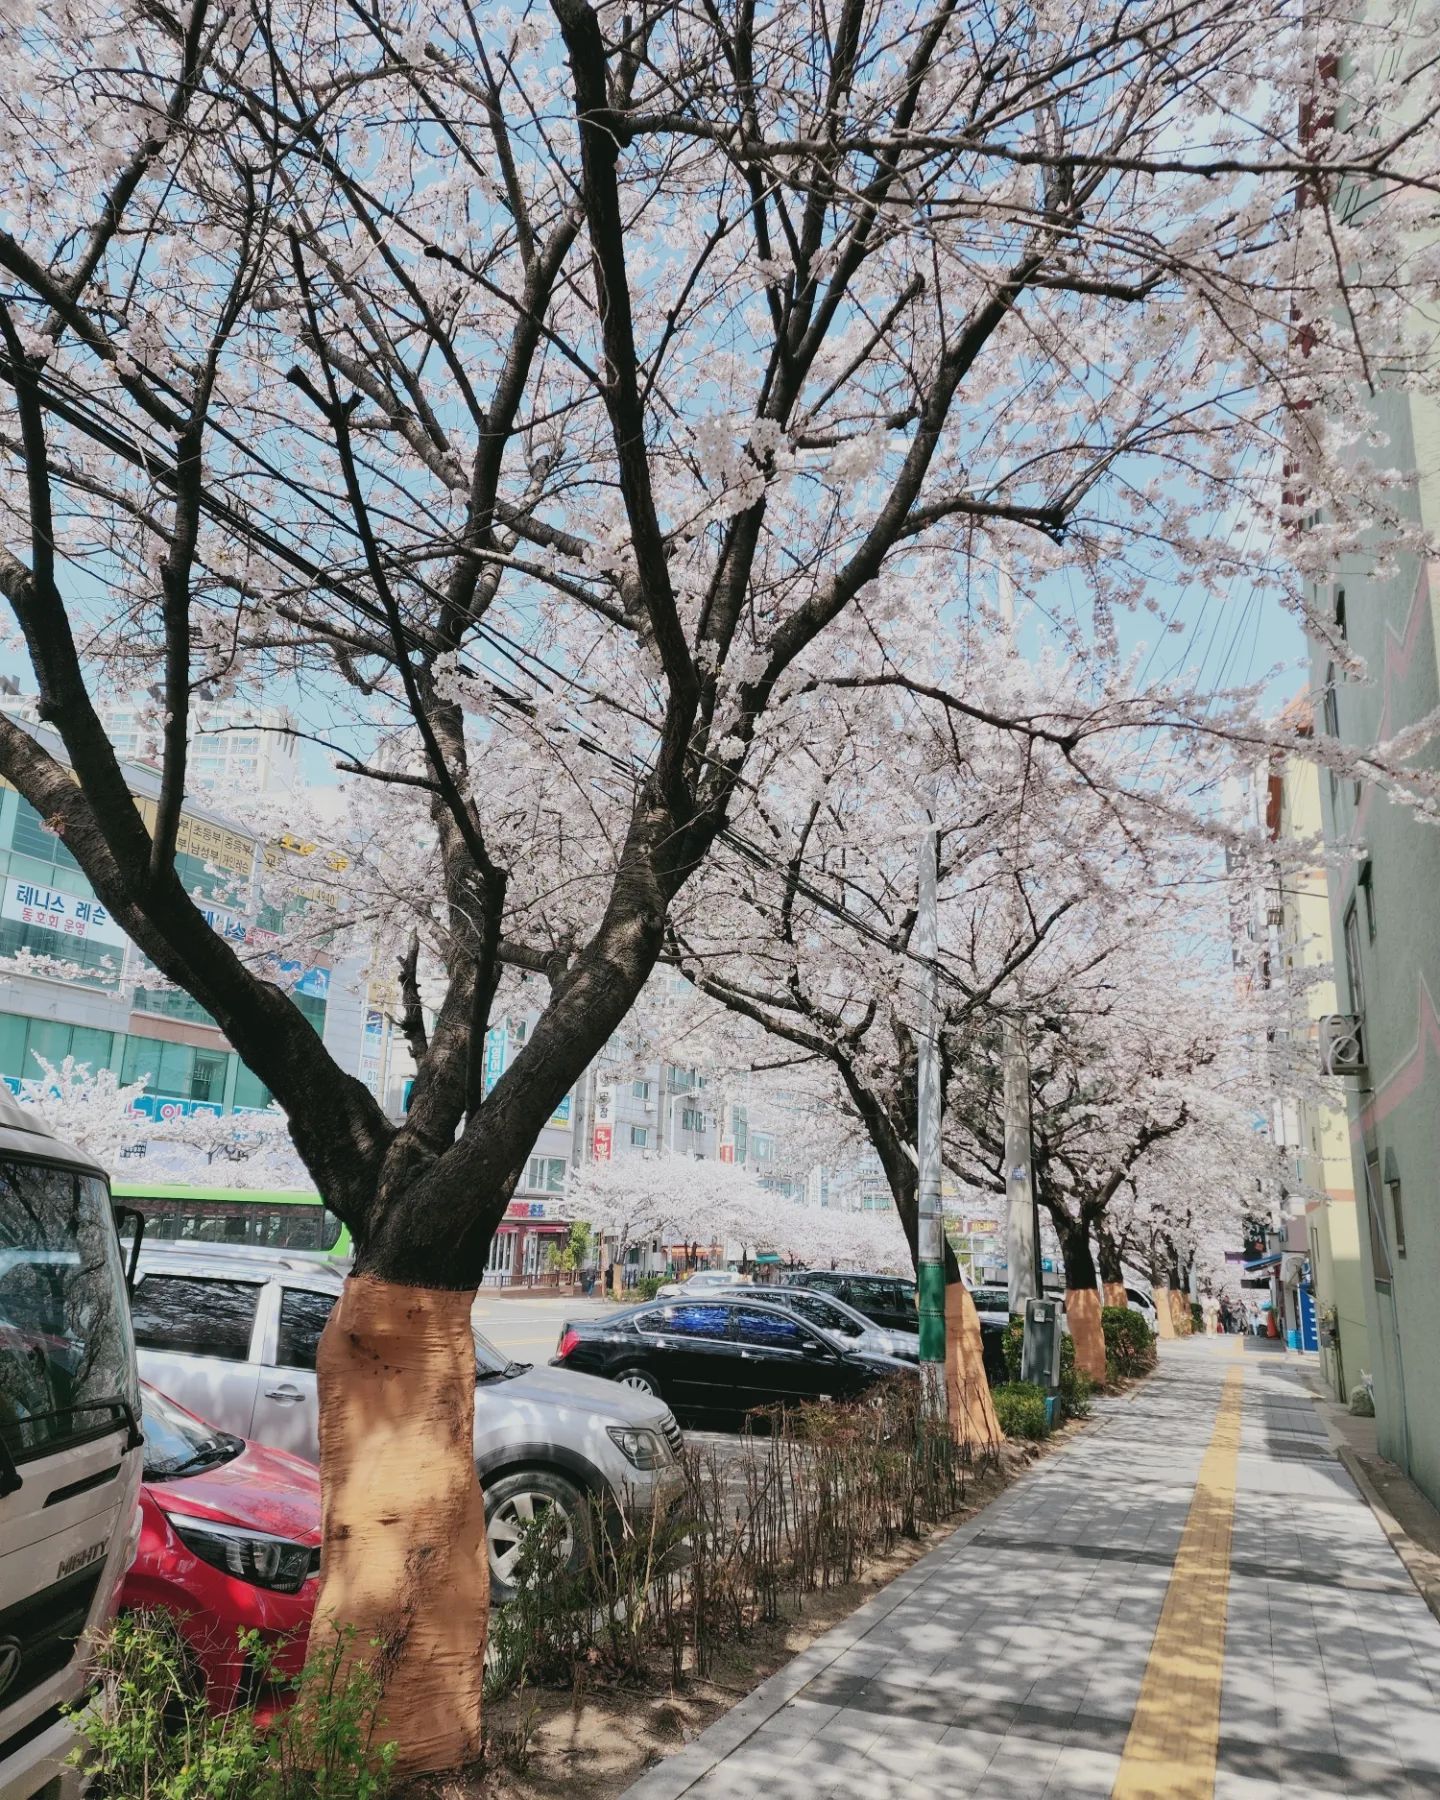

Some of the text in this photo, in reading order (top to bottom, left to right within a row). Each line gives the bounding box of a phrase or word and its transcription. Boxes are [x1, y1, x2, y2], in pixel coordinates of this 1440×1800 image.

[190, 842, 219, 862] 남성부
[192, 824, 222, 845] 초등부
[223, 836, 251, 856] 중등부
[16, 884, 107, 926] 테니스 레슨
[22, 907, 86, 936] 동호회 운영
[56, 1536, 110, 1580] MIGHTY
